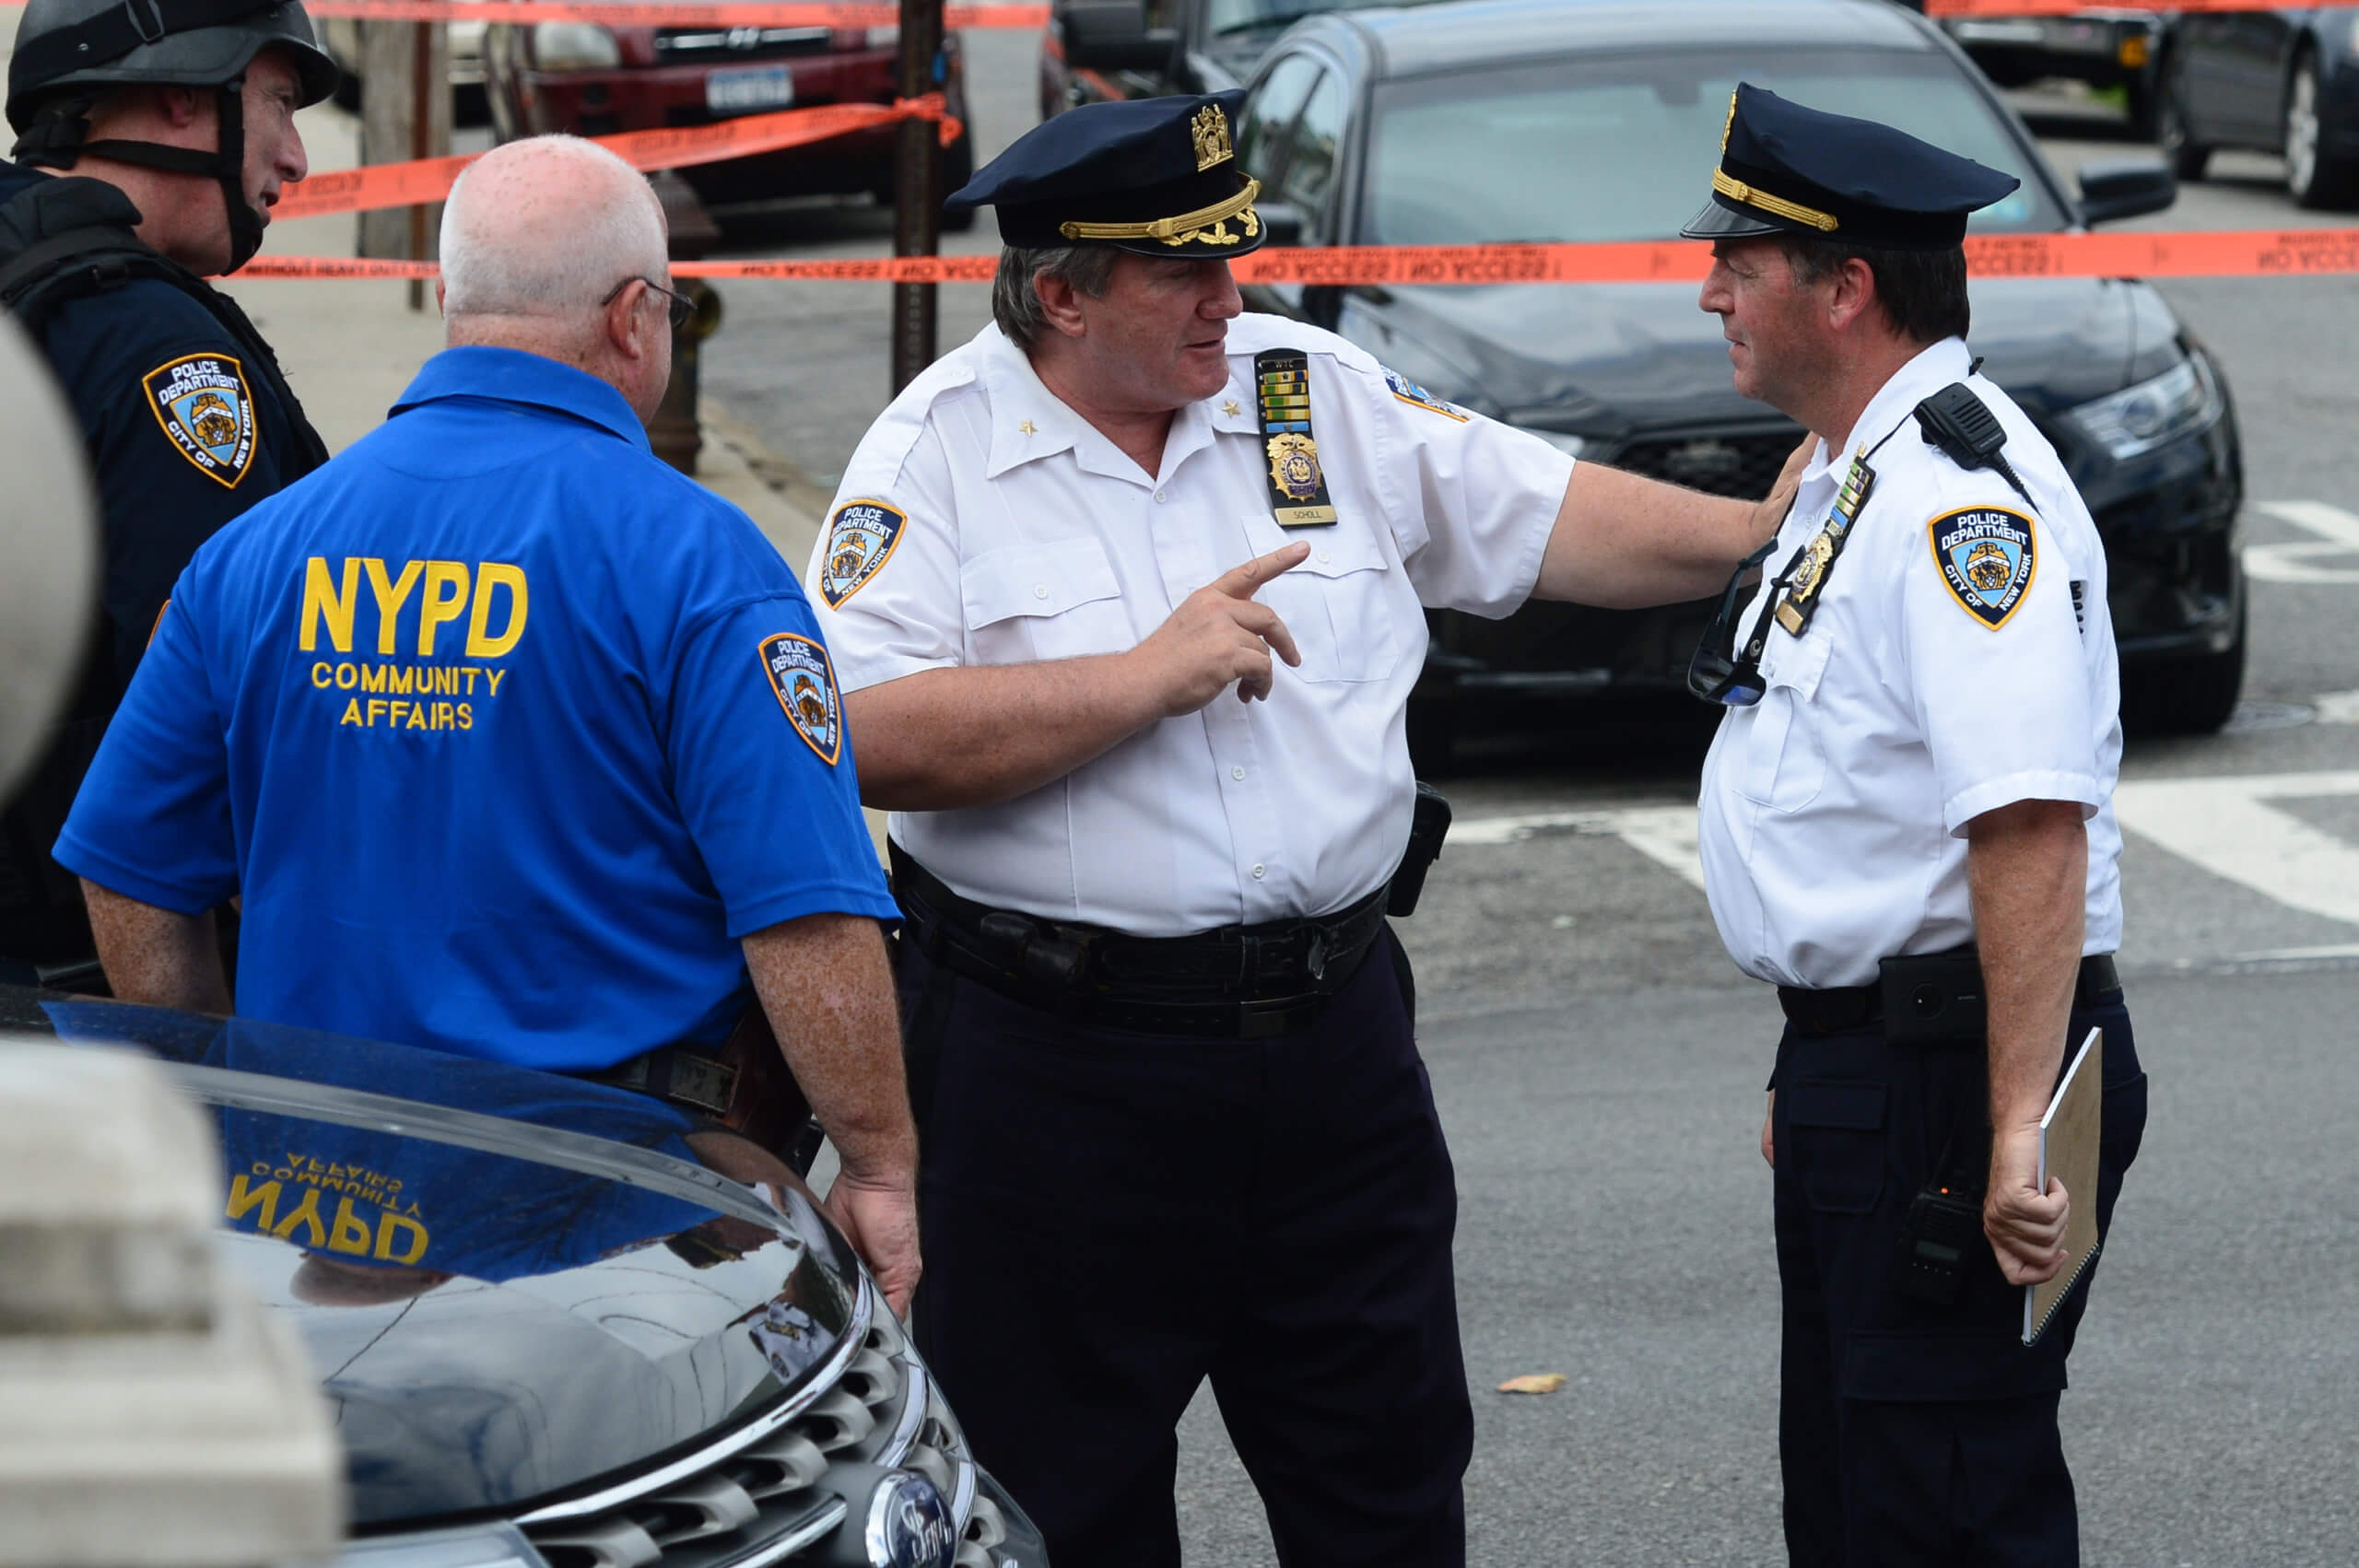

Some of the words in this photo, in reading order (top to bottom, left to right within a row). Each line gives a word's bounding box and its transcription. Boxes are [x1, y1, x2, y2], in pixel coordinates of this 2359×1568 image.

[170, 360, 221, 382] POLICE
[158, 374, 240, 405] DEPARTMENT
[240, 399, 252, 437] YORK
[167, 420, 196, 451] CITY
[194, 451, 216, 468] OF
[232, 439, 251, 469] NEW
[844, 507, 884, 521] POLICE
[1294, 509, 1322, 520] SCHOLL
[1957, 512, 2010, 529] POLICE
[1941, 524, 2028, 551] DEPARTMENT
[841, 575, 863, 596] NEW
[863, 546, 888, 575] YORK
[1944, 564, 1967, 591] CITY
[1966, 592, 1983, 607] OF
[1999, 585, 2021, 612] NEW
[2015, 553, 2033, 585] YORK
[299, 556, 529, 659] NYPD
[777, 639, 811, 657] POLICE
[311, 661, 506, 697] COMMUNITY
[770, 653, 826, 676] DEPARTMENT
[340, 697, 474, 731] AFFAIRS
[780, 688, 799, 718] CITY
[825, 685, 837, 719] YORK
[827, 720, 836, 747] NEW
